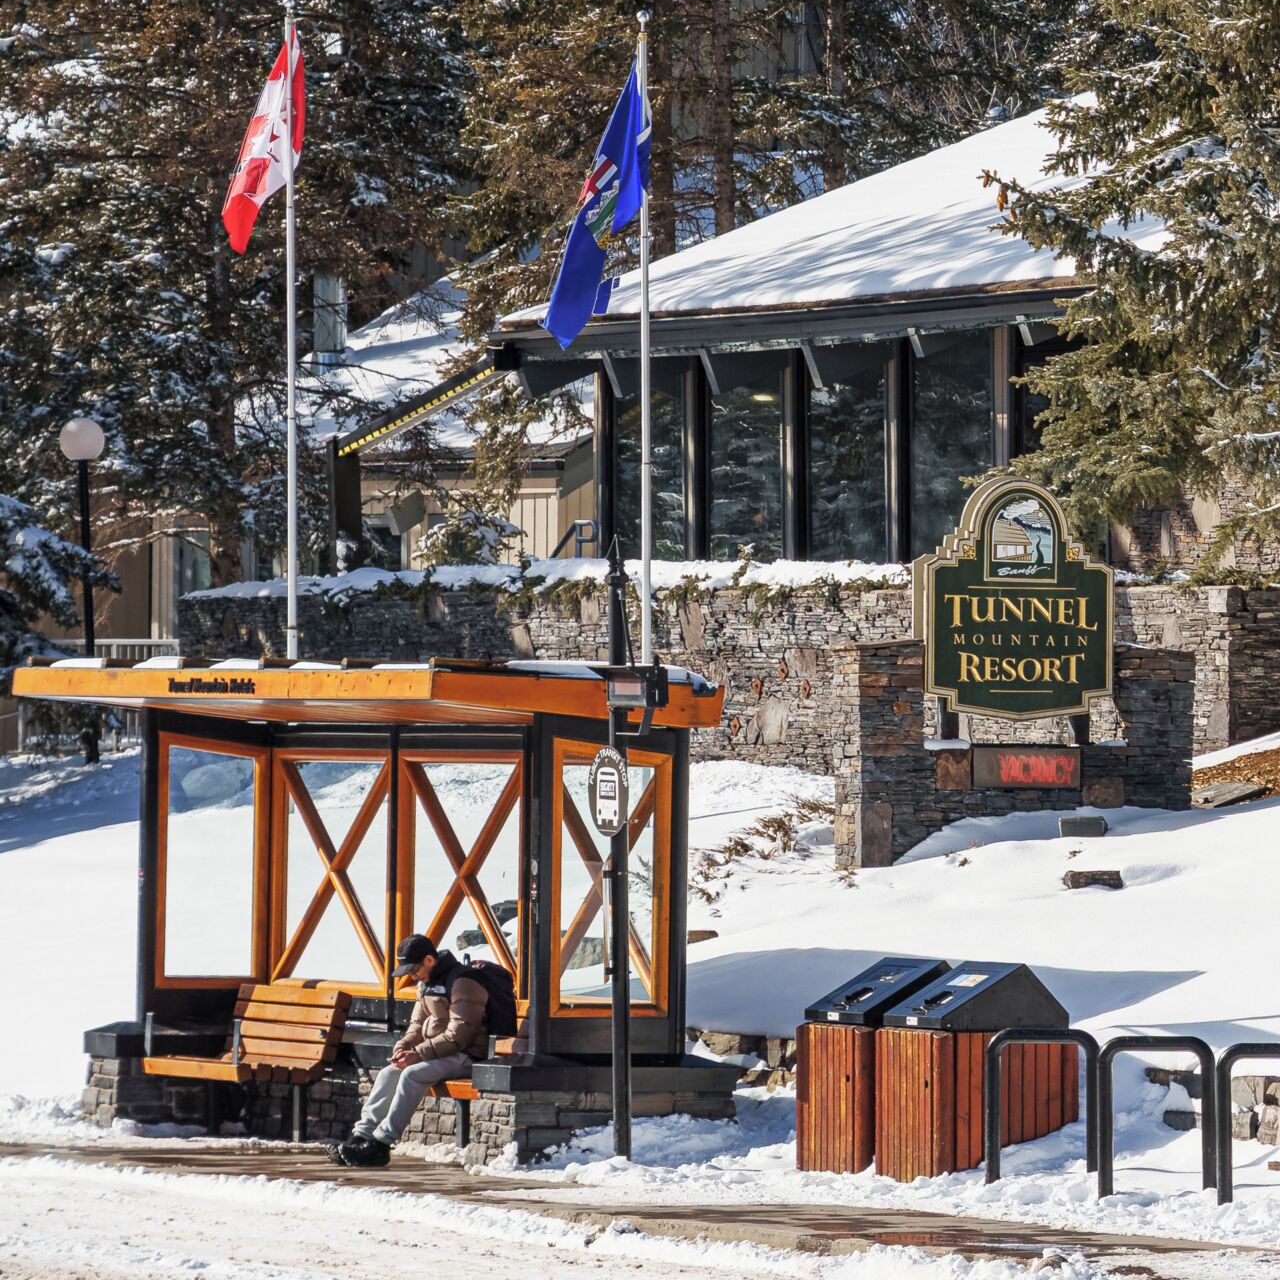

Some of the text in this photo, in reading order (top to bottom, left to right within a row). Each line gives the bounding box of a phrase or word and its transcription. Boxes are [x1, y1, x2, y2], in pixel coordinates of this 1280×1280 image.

[997, 564, 1050, 576] Banff
[944, 594, 1098, 632] TUNNEL
[953, 633, 1089, 647] MOUNTAIN
[957, 651, 1086, 685] RESORT
[599, 748, 621, 763] TRANSIT
[618, 759, 628, 788] STOP
[999, 753, 1075, 785] VACANCY
